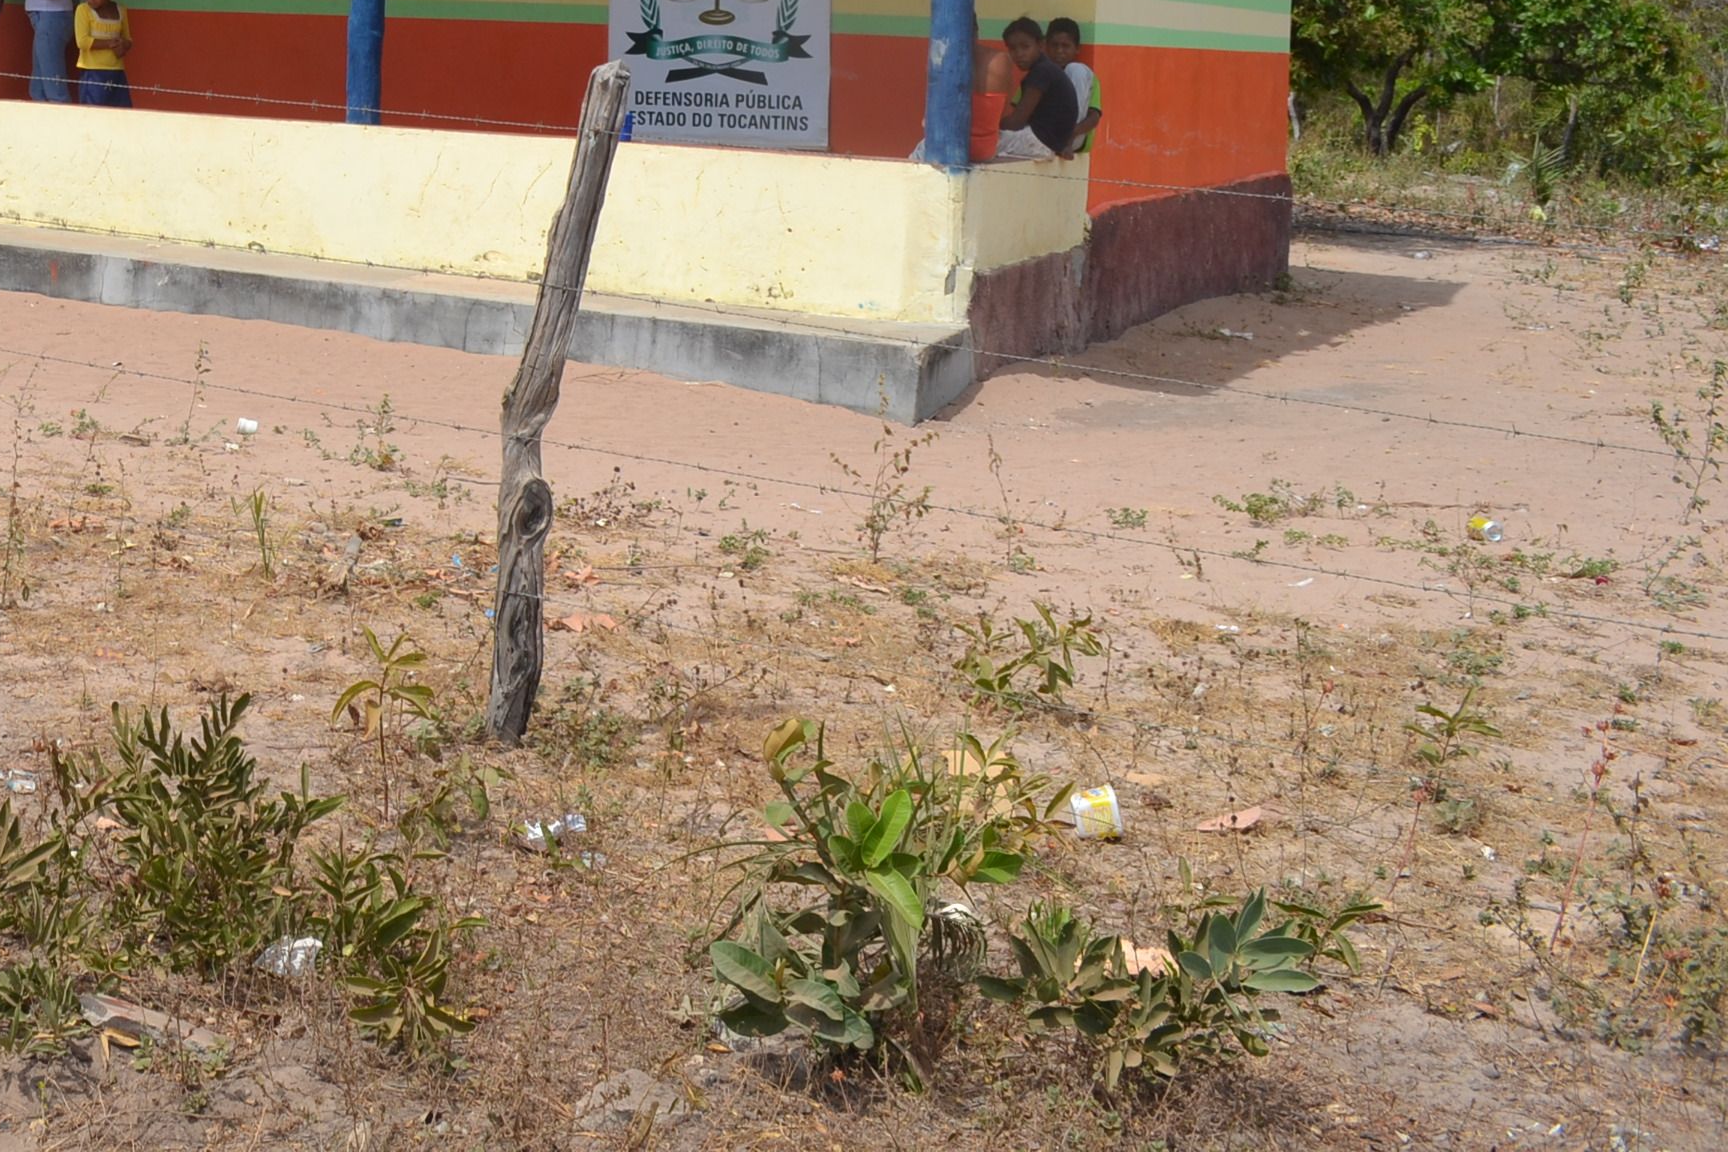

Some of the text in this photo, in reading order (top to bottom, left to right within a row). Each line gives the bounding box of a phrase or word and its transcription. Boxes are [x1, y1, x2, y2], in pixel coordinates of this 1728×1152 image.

[656, 39, 780, 58] JUSTIÇA, DIREITO DE TODOS
[635, 89, 803, 110] DEFENSORIA PÚBLICA
[629, 110, 809, 131] ESTADO DO TOCANTINS
